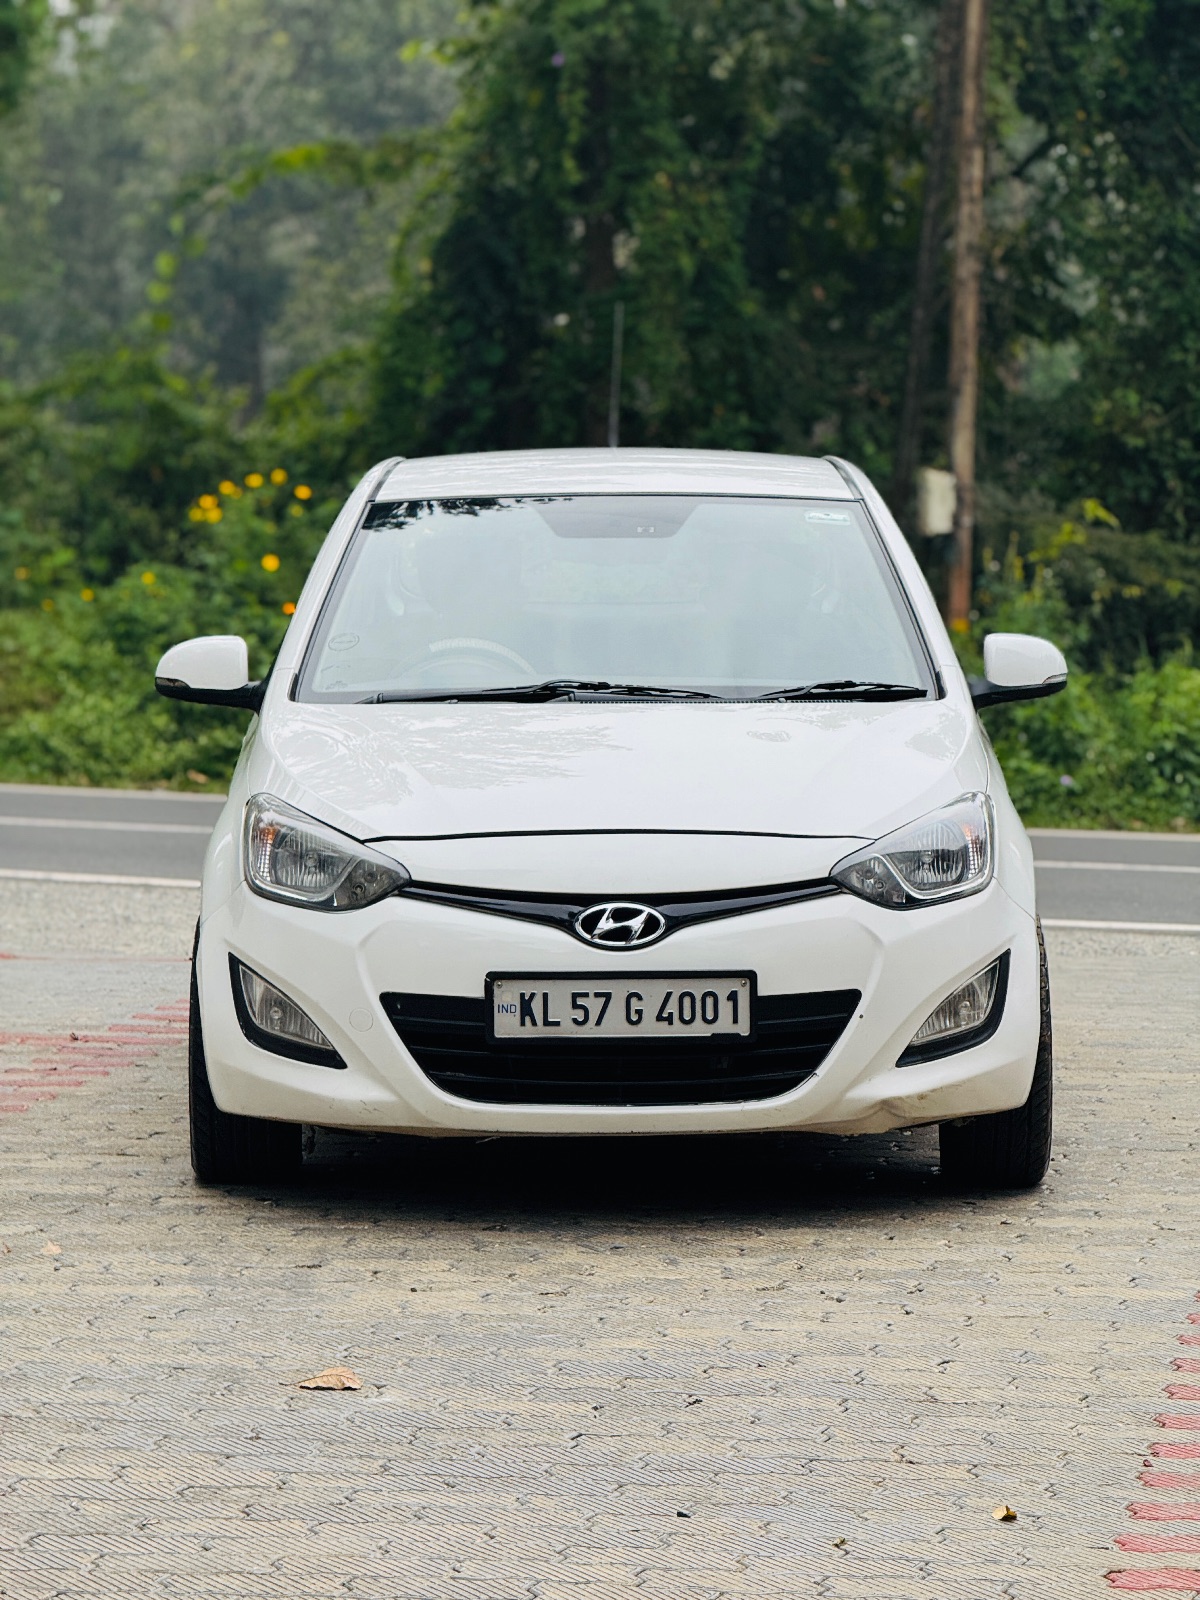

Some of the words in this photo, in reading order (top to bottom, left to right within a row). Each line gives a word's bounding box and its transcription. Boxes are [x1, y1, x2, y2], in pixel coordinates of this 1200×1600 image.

[497, 1004, 517, 1014] IND
[520, 991, 561, 1027] KL
[571, 991, 612, 1026] 57
[625, 991, 644, 1025] G
[655, 990, 739, 1025] 4001
